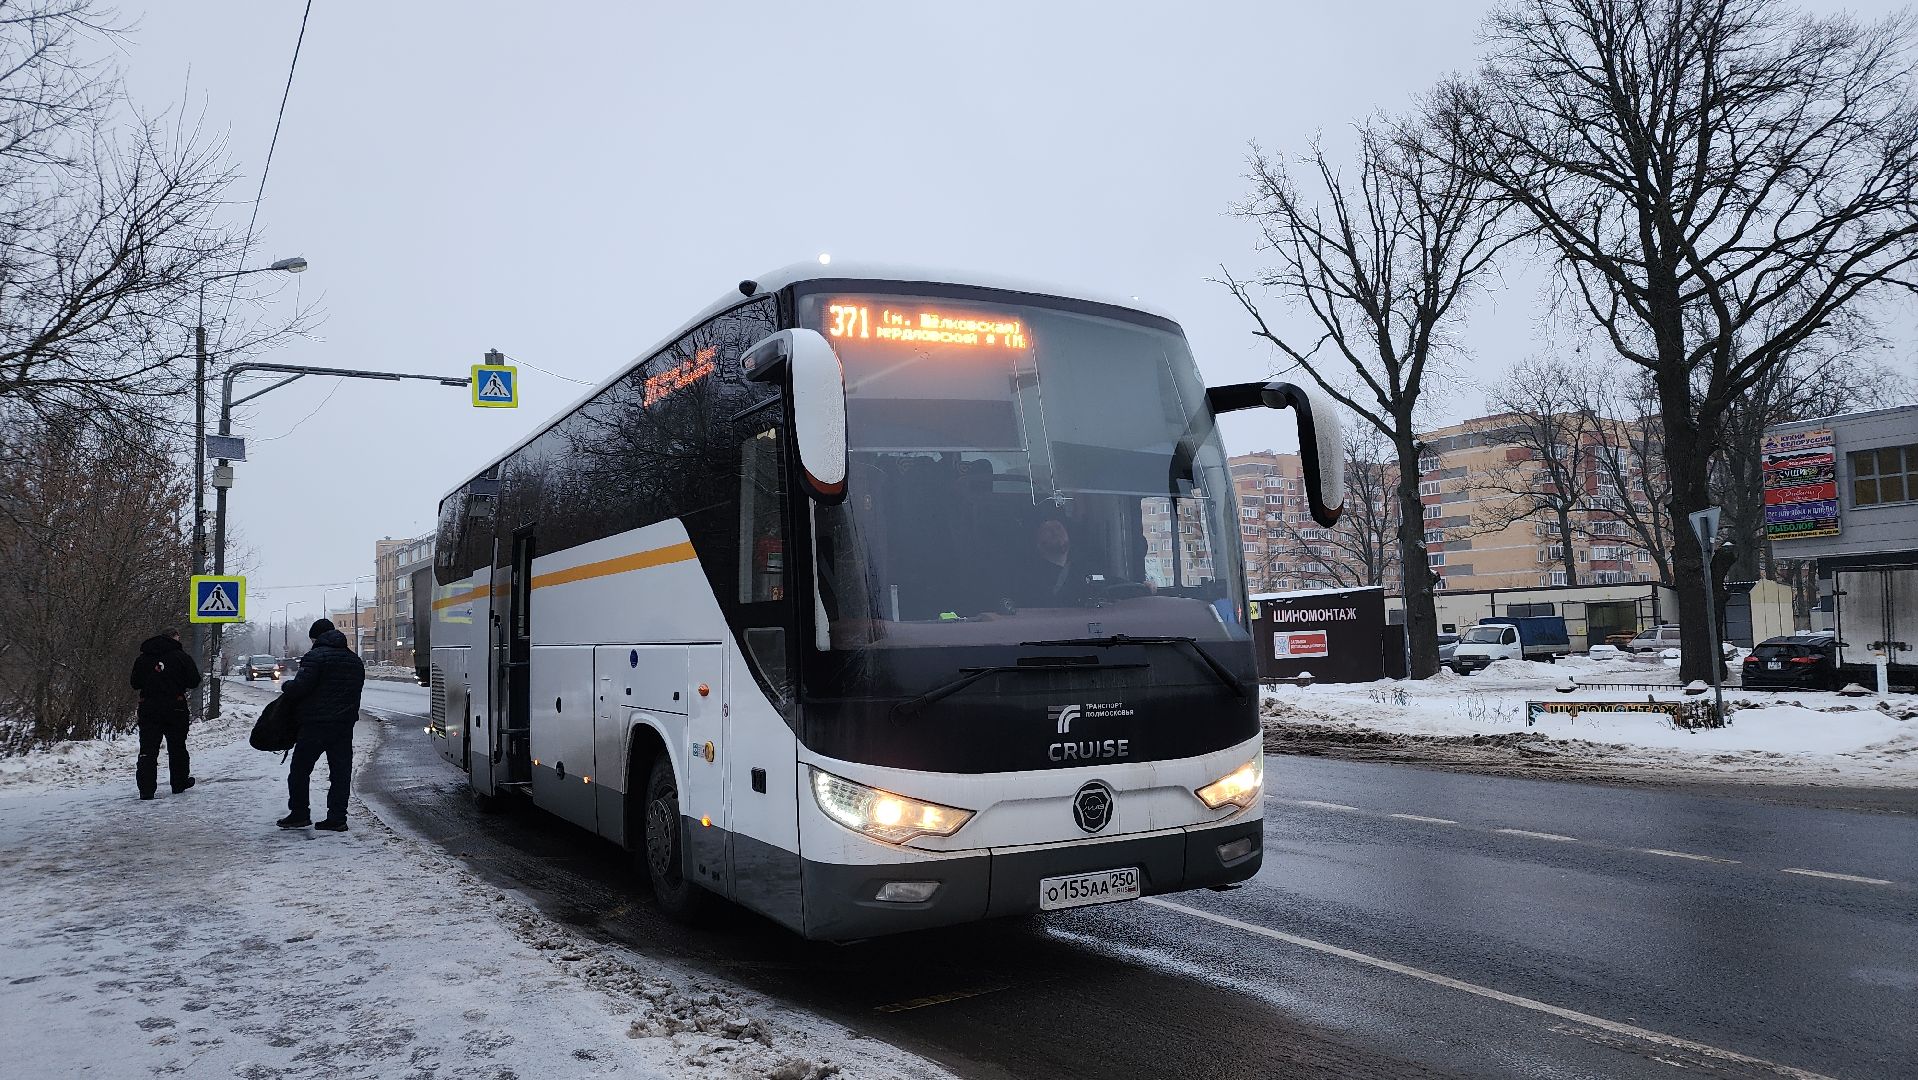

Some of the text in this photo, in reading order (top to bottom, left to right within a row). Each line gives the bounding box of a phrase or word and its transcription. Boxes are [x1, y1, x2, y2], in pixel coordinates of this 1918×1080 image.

[830, 304, 869, 339] 371
[1273, 607, 1357, 623] ШИНОМОНТАЖ
[1085, 709, 1134, 718] ПОДМОСКОВЬЯ
[1086, 702, 1123, 710] ТРАНСПОРТ
[1048, 740, 1129, 761] CRUISE
